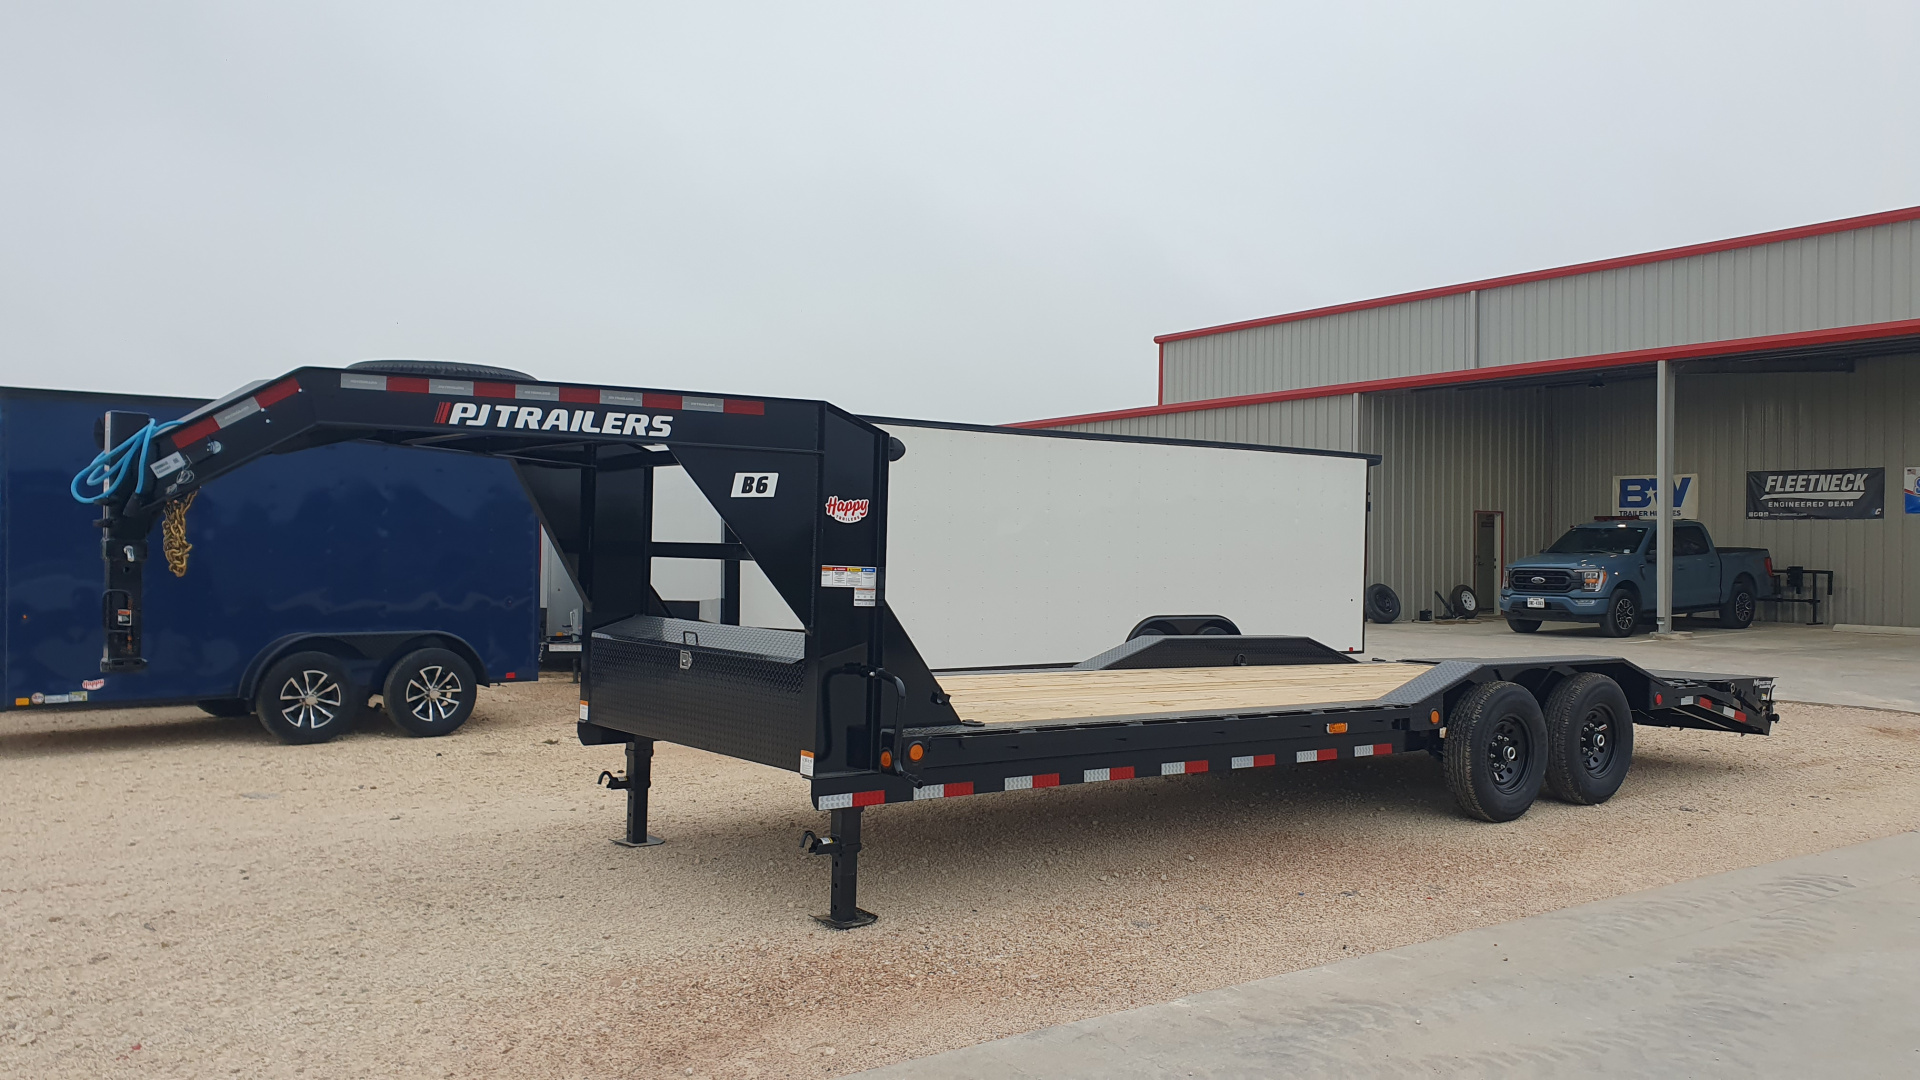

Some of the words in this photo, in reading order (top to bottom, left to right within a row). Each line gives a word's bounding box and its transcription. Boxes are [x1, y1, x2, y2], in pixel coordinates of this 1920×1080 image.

[448, 402, 492, 426] PJ
[494, 404, 674, 438] TRAILERS
[741, 476, 769, 494] B6
[1764, 473, 1869, 492] FLEETNECK
[826, 497, 868, 517] Happy
[1827, 500, 1854, 508] BEAM
